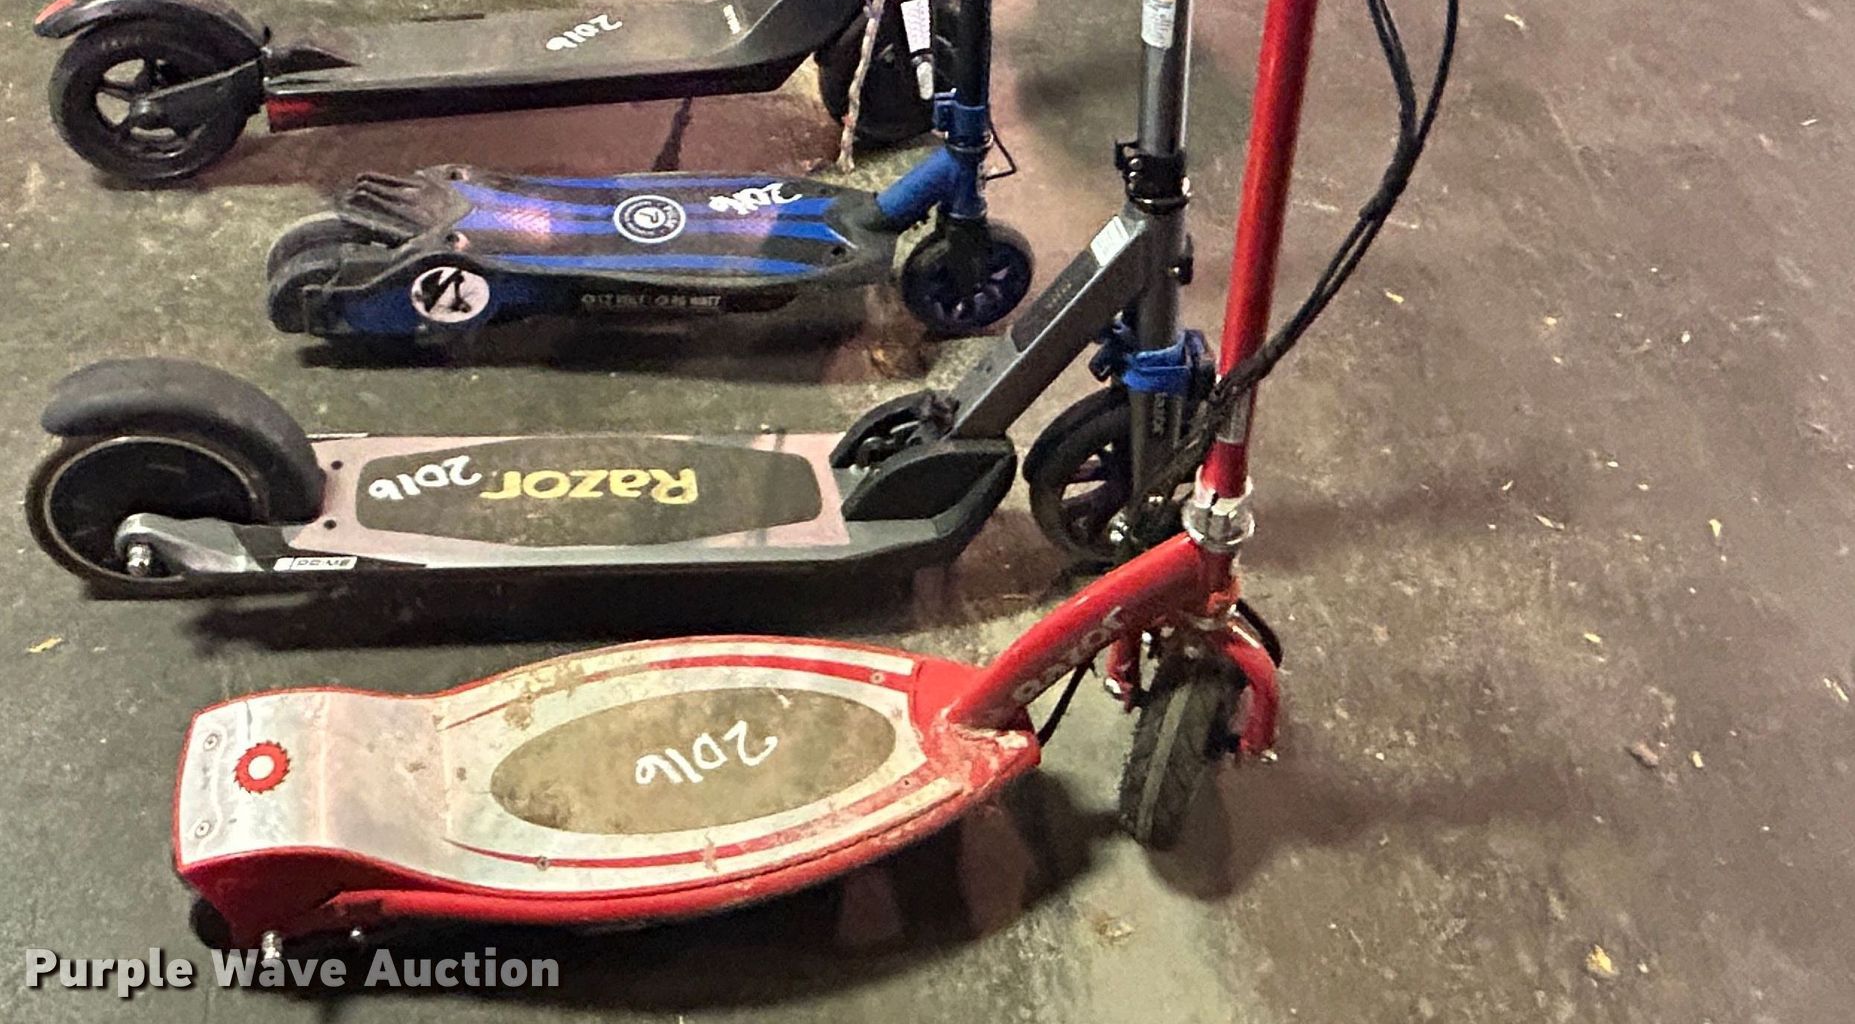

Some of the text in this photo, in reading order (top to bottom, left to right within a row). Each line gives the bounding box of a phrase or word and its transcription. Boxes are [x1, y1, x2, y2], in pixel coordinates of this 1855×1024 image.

[545, 14, 623, 51] 2016
[368, 455, 482, 500] 2016
[479, 468, 698, 505] Razor
[634, 719, 779, 785] 2016
